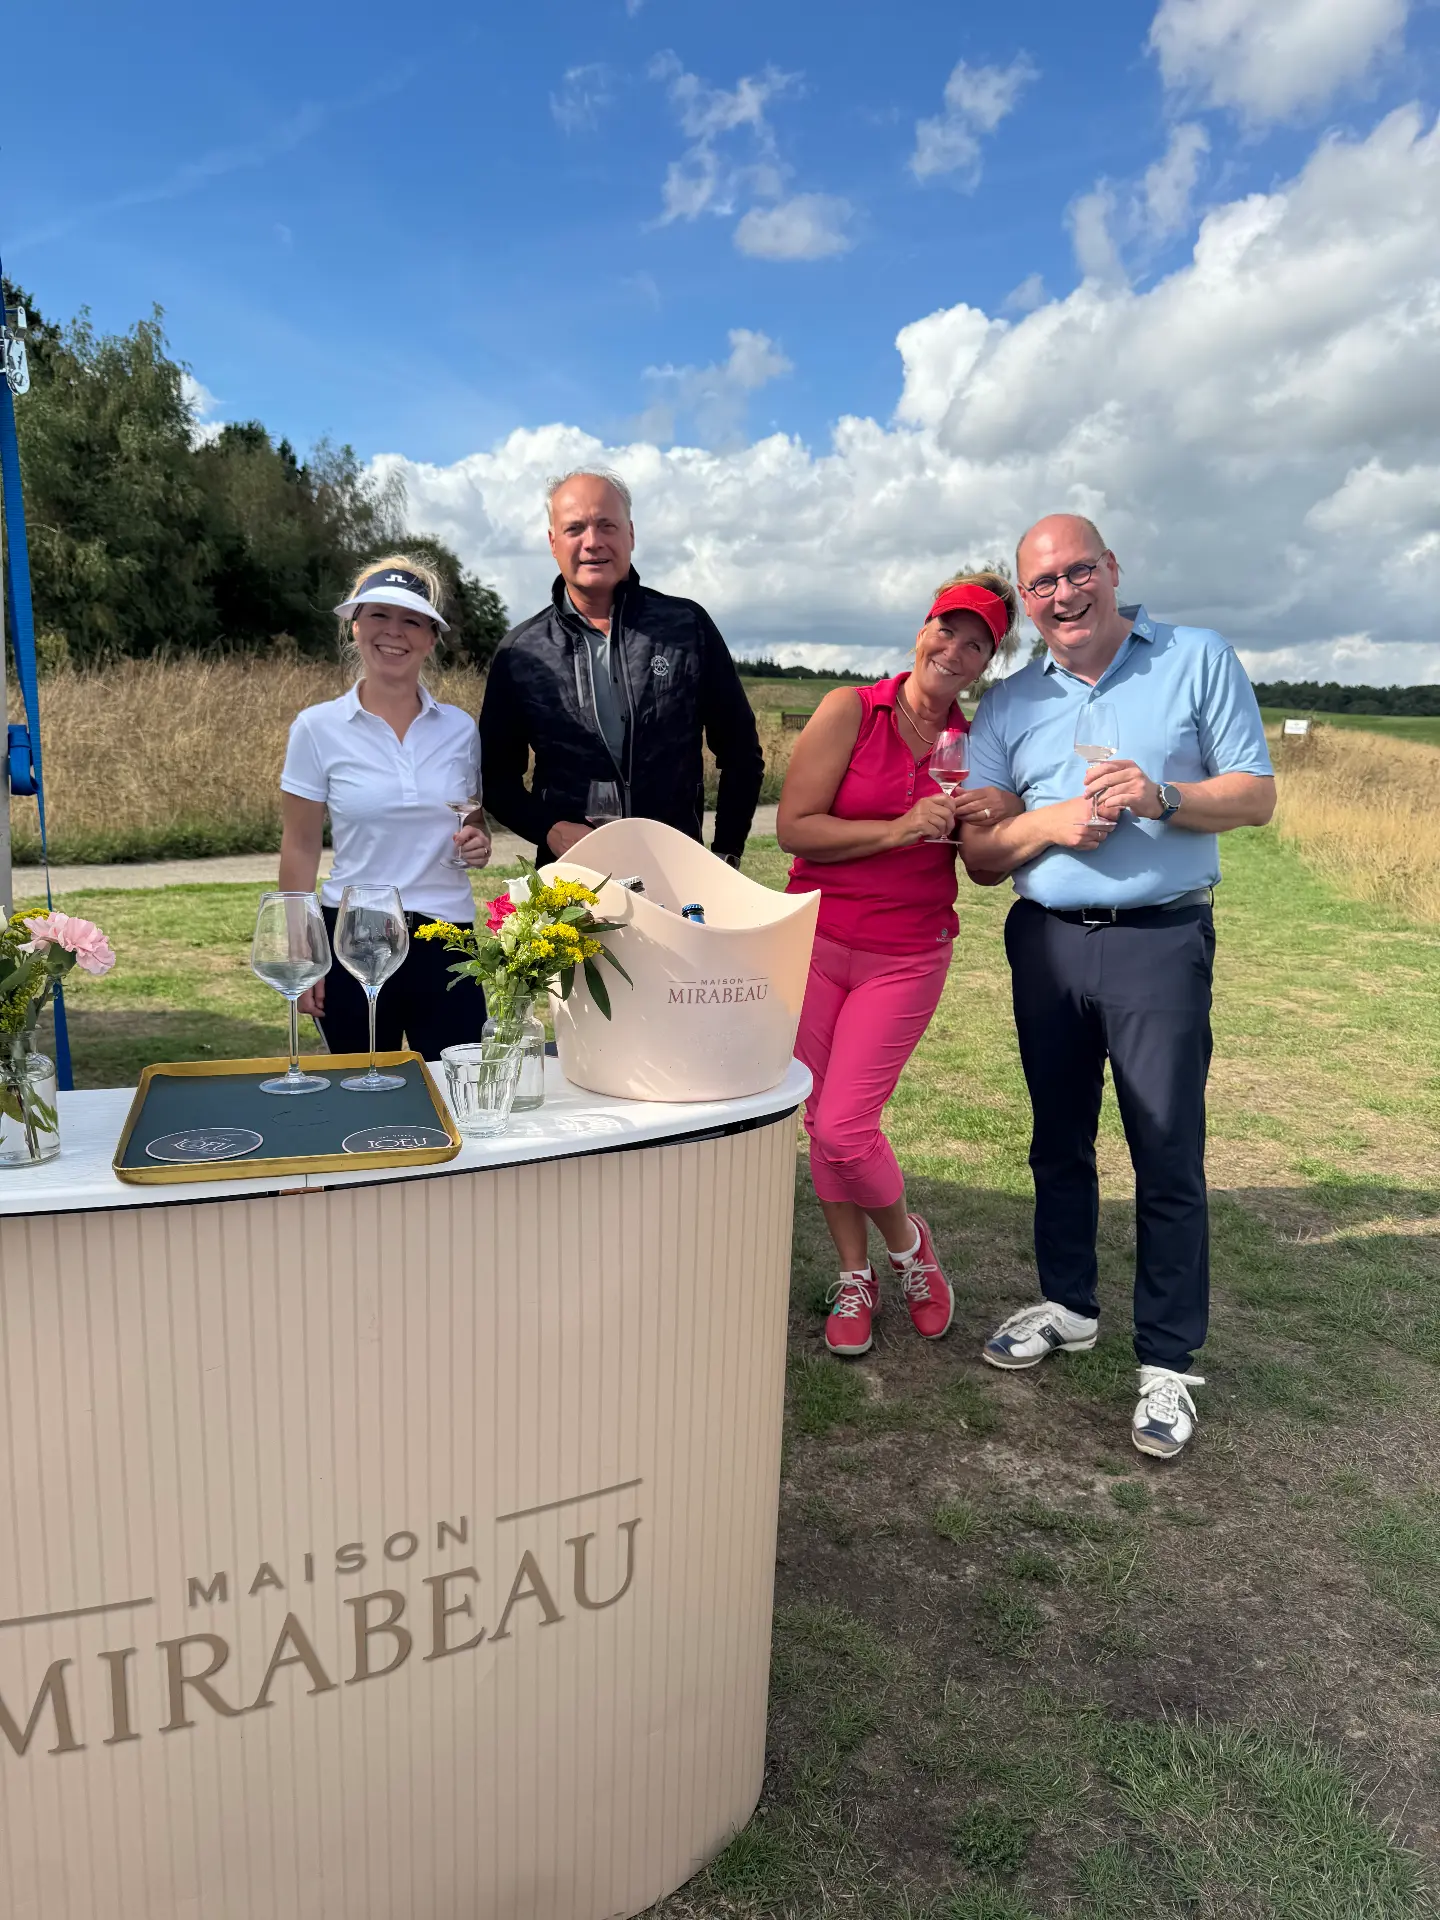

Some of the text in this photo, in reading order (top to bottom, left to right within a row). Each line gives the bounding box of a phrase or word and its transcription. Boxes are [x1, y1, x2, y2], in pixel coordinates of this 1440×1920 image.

[700, 978, 744, 986] MAISON
[667, 984, 768, 1004] MIRABEAU
[186, 1515, 469, 1608] MAISON
